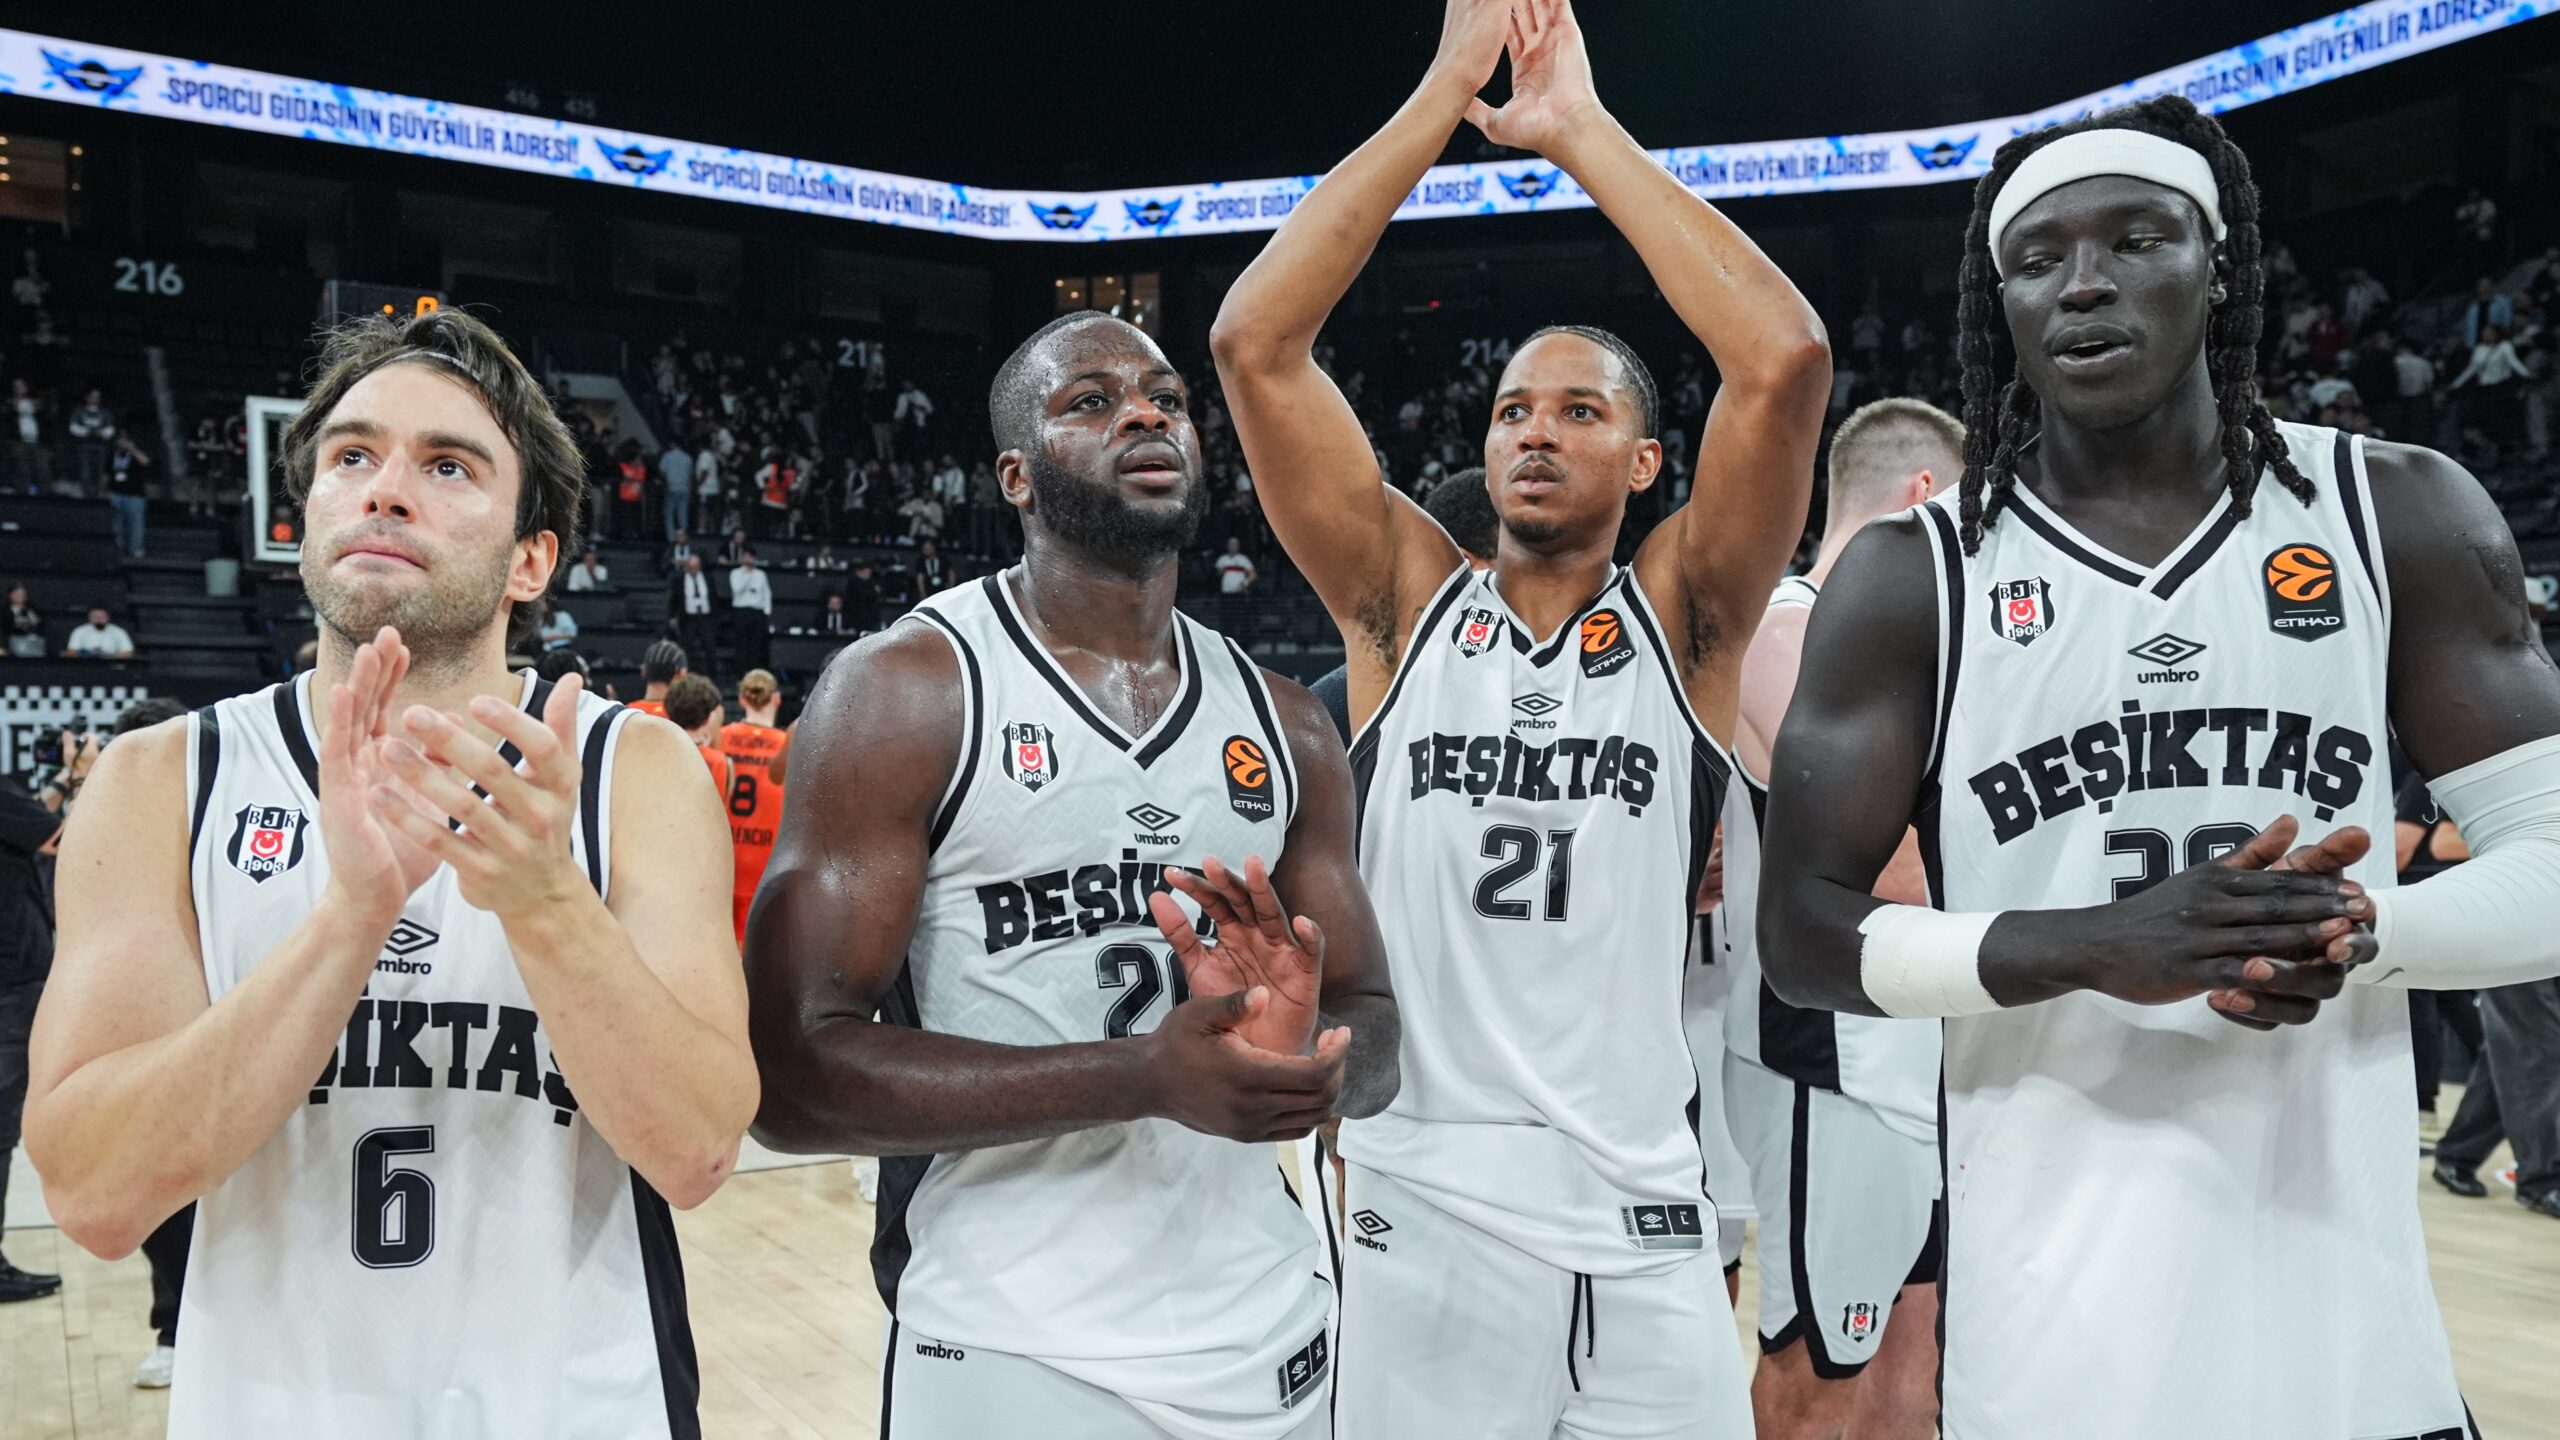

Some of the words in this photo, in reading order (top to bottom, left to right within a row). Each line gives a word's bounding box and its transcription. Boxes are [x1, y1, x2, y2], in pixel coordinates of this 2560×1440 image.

[2294, 13, 2410, 75] GÜVENİLİR
[2418, 0, 2513, 37] ADRES
[168, 77, 263, 116] SPORCU
[269, 93, 382, 134] GIDASININ
[388, 108, 495, 152] GÜVENİLİR
[502, 130, 579, 164] ADRESİ!
[1673, 158, 1728, 186] ASININ
[688, 159, 762, 192] SPORCU
[767, 171, 854, 205] GIDASININ
[859, 183, 943, 221] GÜVENİLİR
[1197, 197, 1256, 221] SPORCU
[114, 257, 183, 296] 216
[838, 339, 867, 368] 21
[1460, 337, 1509, 366] 214
[2000, 582, 2040, 600] BJK
[1468, 610, 1499, 625] BJK
[2273, 616, 2341, 628] ETIHAD
[2008, 625, 2043, 638] 1903
[1460, 642, 1485, 653] 1903
[1588, 649, 1632, 675] ETIHAD
[2136, 668, 2200, 684] umbro
[1511, 718, 1557, 729] umbro
[1011, 727, 1045, 742] BJK
[1018, 772, 1050, 783] 1903
[1408, 727, 1659, 818] BEŞİKTAŞ
[1967, 699, 2373, 846] BEŞİKTAŞ
[730, 774, 757, 817] 8
[1232, 799, 1272, 812] ETIHAD
[248, 810, 297, 829] BJK
[1134, 831, 1181, 846] umbro
[244, 860, 285, 872] 1903
[1472, 823, 1577, 922] 21
[374, 957, 432, 975] mbro
[1095, 943, 1192, 1039] 2
[351, 1124, 436, 1270] 6
[1680, 1215, 1690, 1225] L
[1354, 1233, 1388, 1253] umbro
[916, 1342, 965, 1362] umbro
